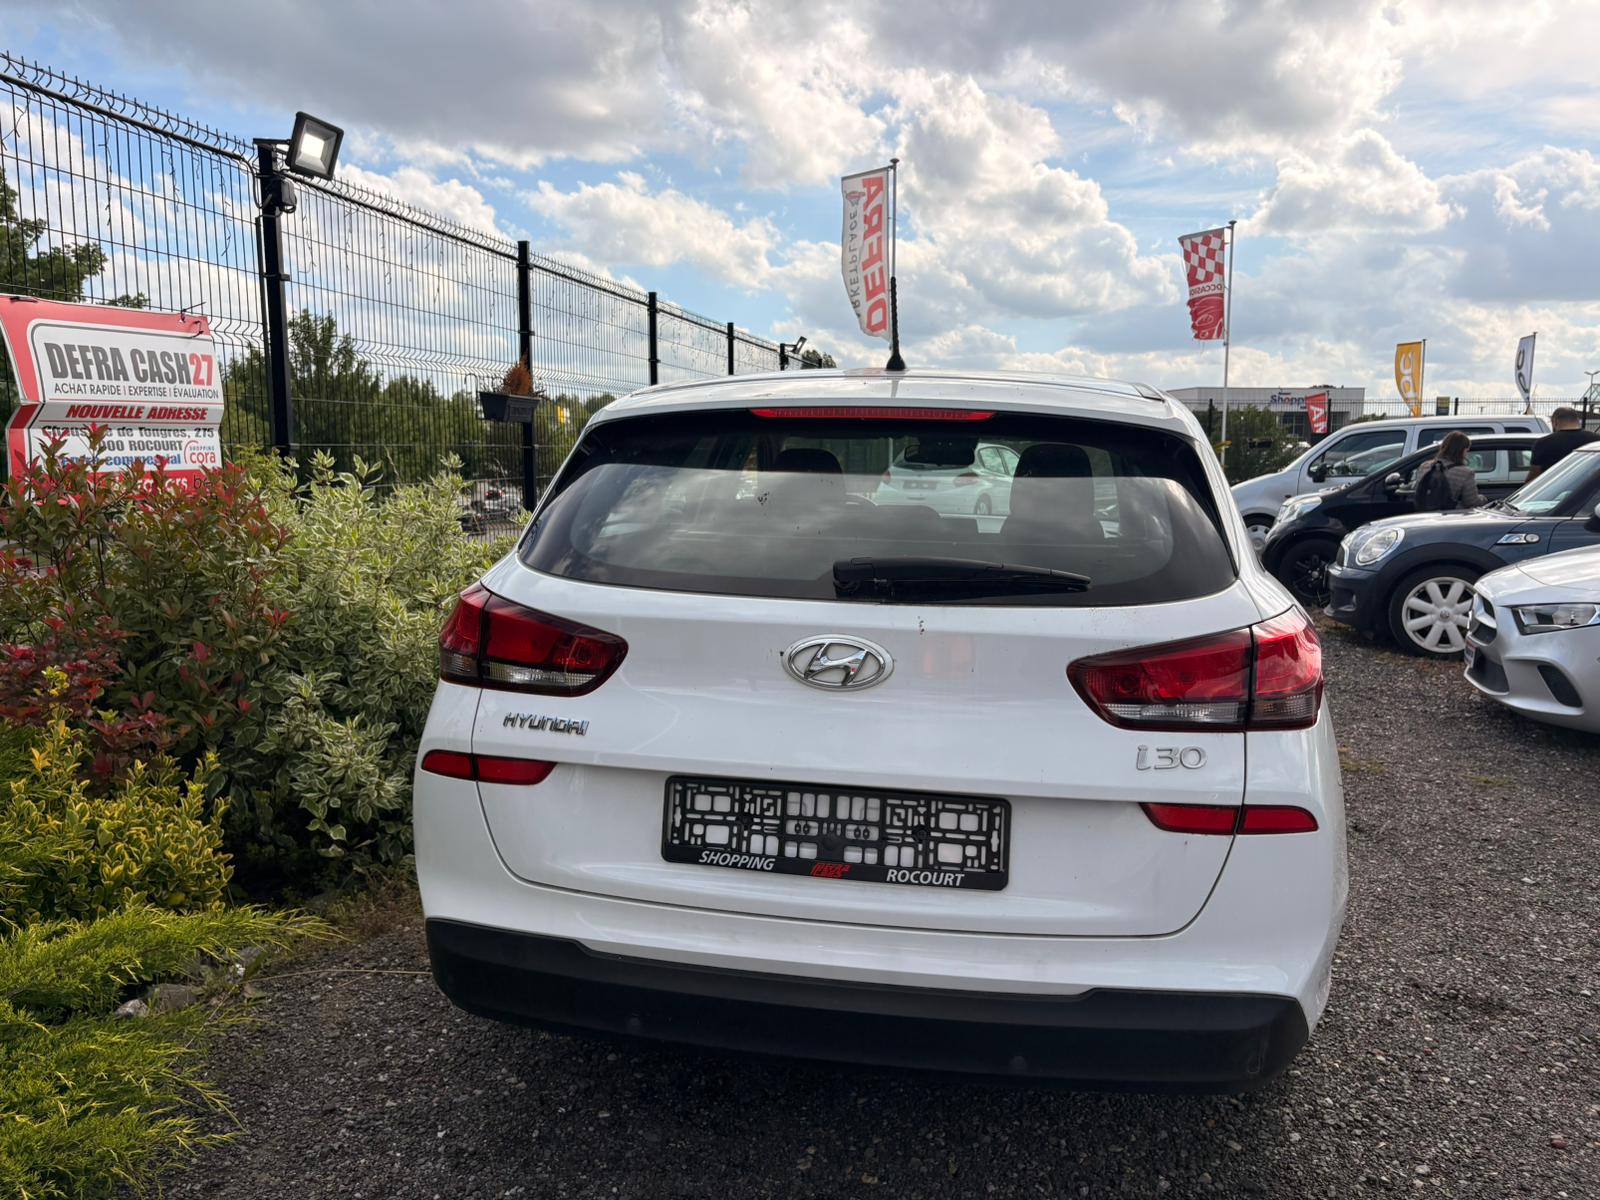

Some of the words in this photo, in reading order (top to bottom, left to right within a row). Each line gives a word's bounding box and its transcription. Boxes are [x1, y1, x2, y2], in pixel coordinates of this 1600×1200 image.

[44, 342, 129, 381] DEFRA
[54, 382, 87, 394] ACHAT
[90, 384, 121, 396] RAPIDE
[128, 385, 167, 397] EXPERTISE
[173, 386, 219, 399] ÉVALUATION
[65, 404, 144, 419] NOUVELLE
[146, 406, 208, 420] ADRESSE
[117, 426, 134, 438] de
[194, 427, 214, 438] 275
[129, 440, 182, 451] ROCOURT
[189, 452, 216, 464] cora
[503, 712, 589, 736] HYUNDAI
[699, 850, 776, 871] SHOPPING
[886, 868, 965, 887] ROCOURT
